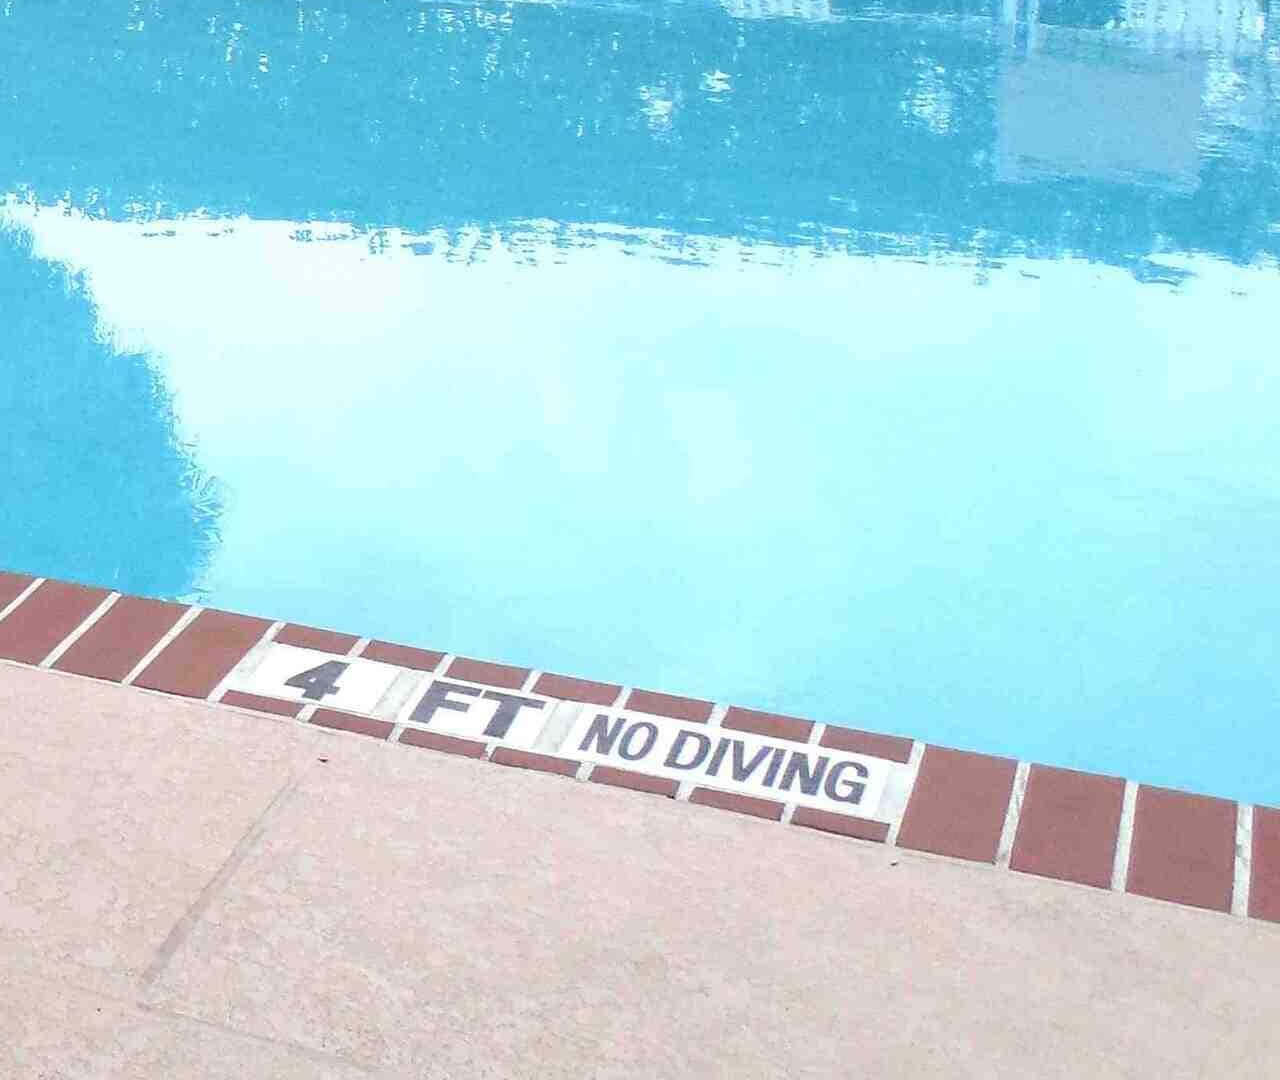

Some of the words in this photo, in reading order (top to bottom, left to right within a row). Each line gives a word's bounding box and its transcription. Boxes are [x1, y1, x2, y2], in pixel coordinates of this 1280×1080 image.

[282, 660, 352, 700] 4
[409, 679, 547, 739] FT
[578, 712, 659, 761] NO
[663, 729, 871, 807] DIVING
